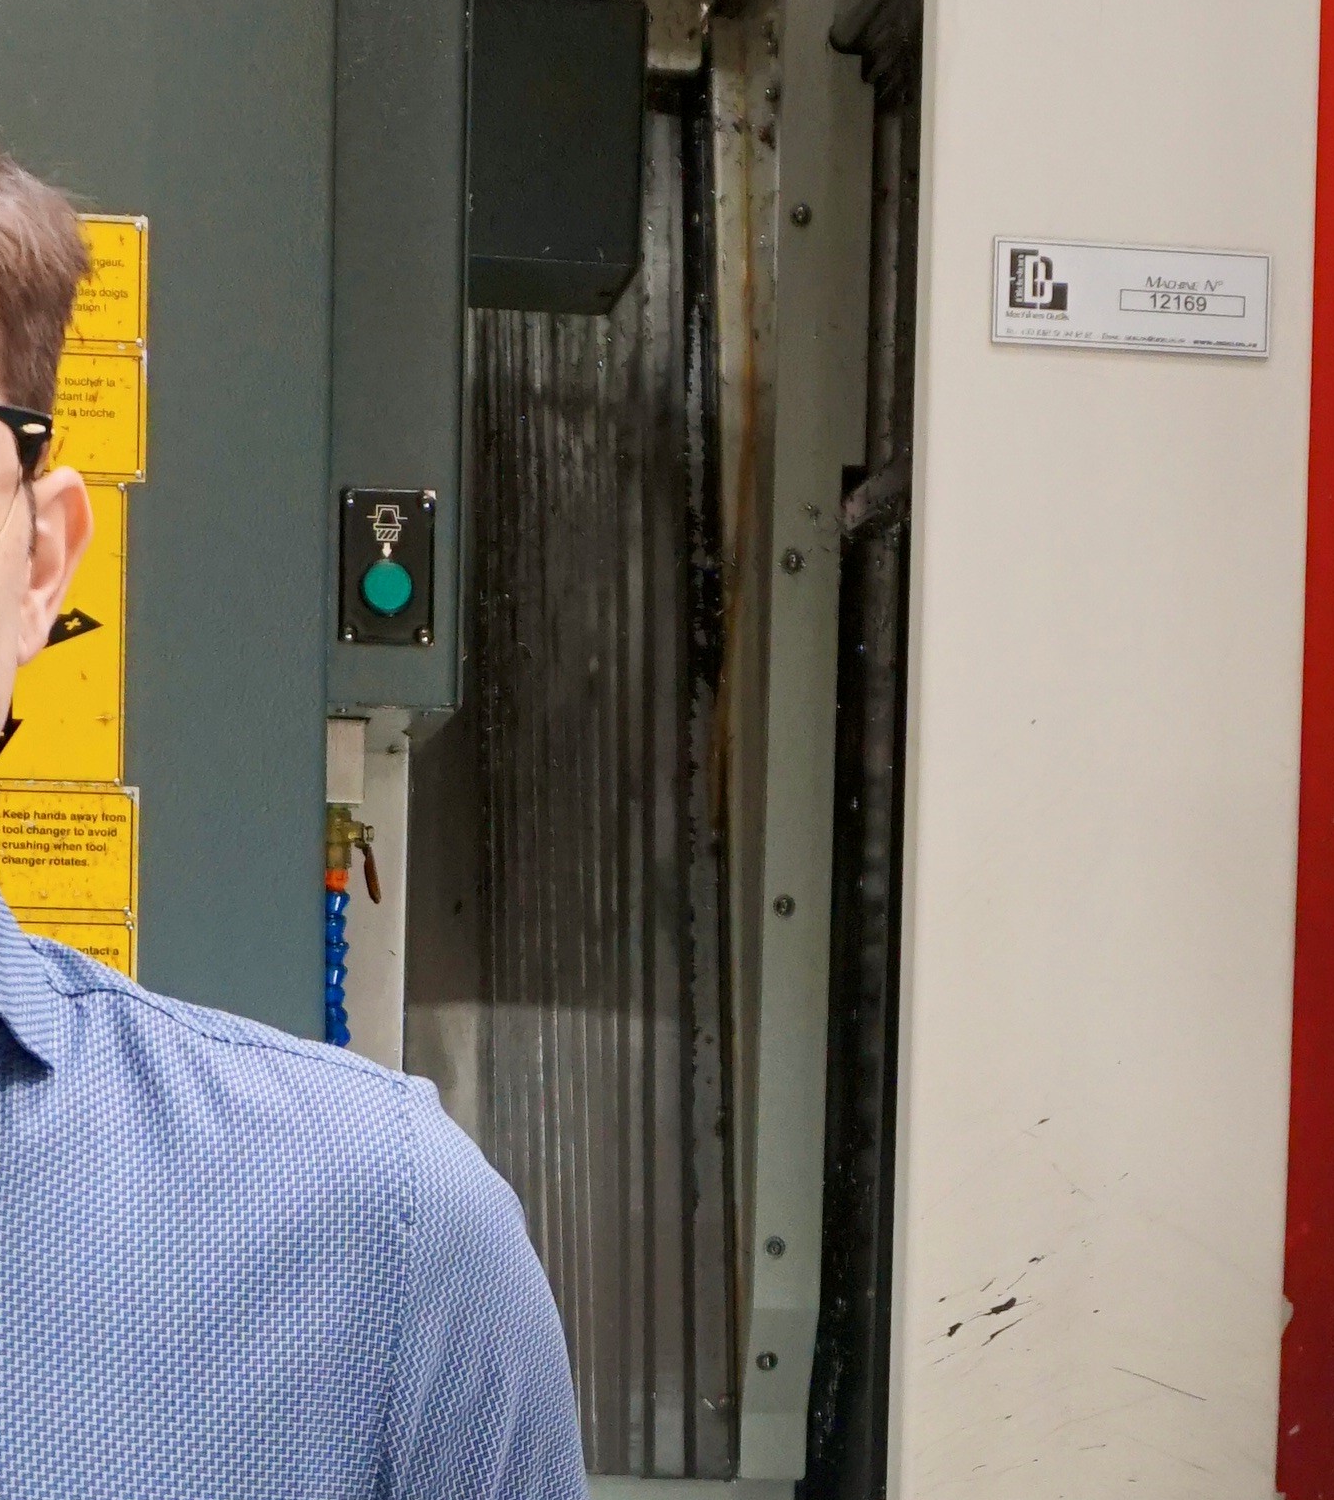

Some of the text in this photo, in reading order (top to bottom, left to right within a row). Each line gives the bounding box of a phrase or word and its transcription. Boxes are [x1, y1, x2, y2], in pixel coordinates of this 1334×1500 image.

[99, 288, 128, 299] doigts
[1150, 293, 1207, 312] 12169
[65, 377, 104, 388] toucher
[107, 378, 116, 387] la
[67, 408, 77, 417] la
[80, 409, 115, 418] broche
[2, 809, 126, 823] Keep hands away from
[2, 826, 117, 838] tool changer to avoid
[2, 841, 106, 852] crushing when tool
[2, 856, 89, 867] changer rotates.
